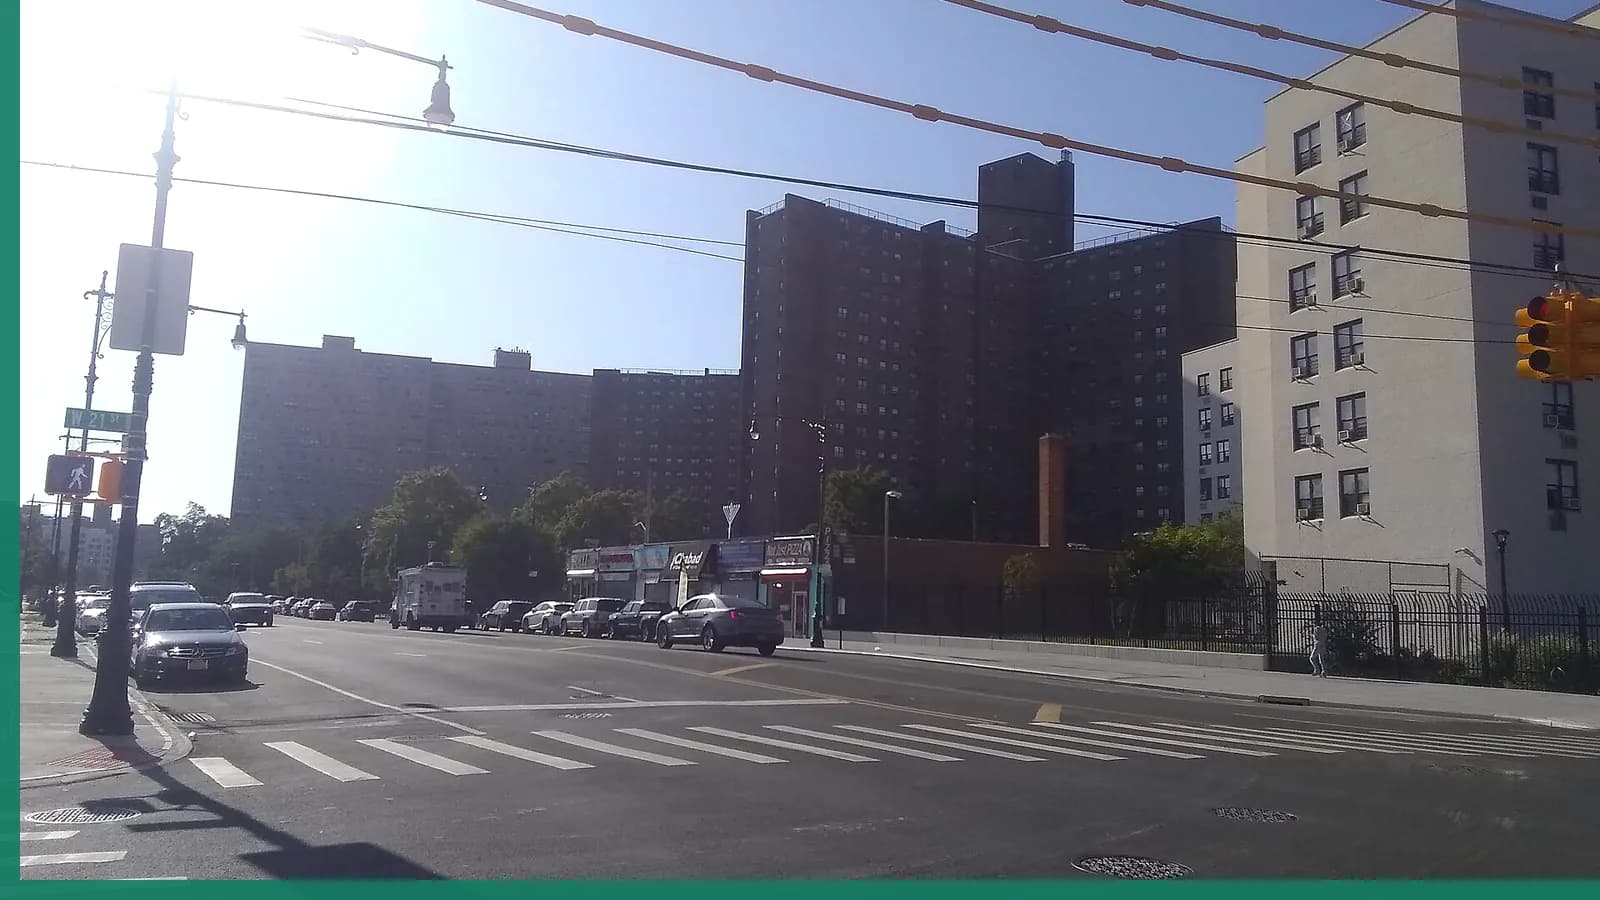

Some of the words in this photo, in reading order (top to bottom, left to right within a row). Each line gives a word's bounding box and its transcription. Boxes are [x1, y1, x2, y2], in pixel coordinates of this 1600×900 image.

[72, 410, 82, 426] W
[89, 412, 105, 428] 21
[787, 543, 803, 556] PIZZA
